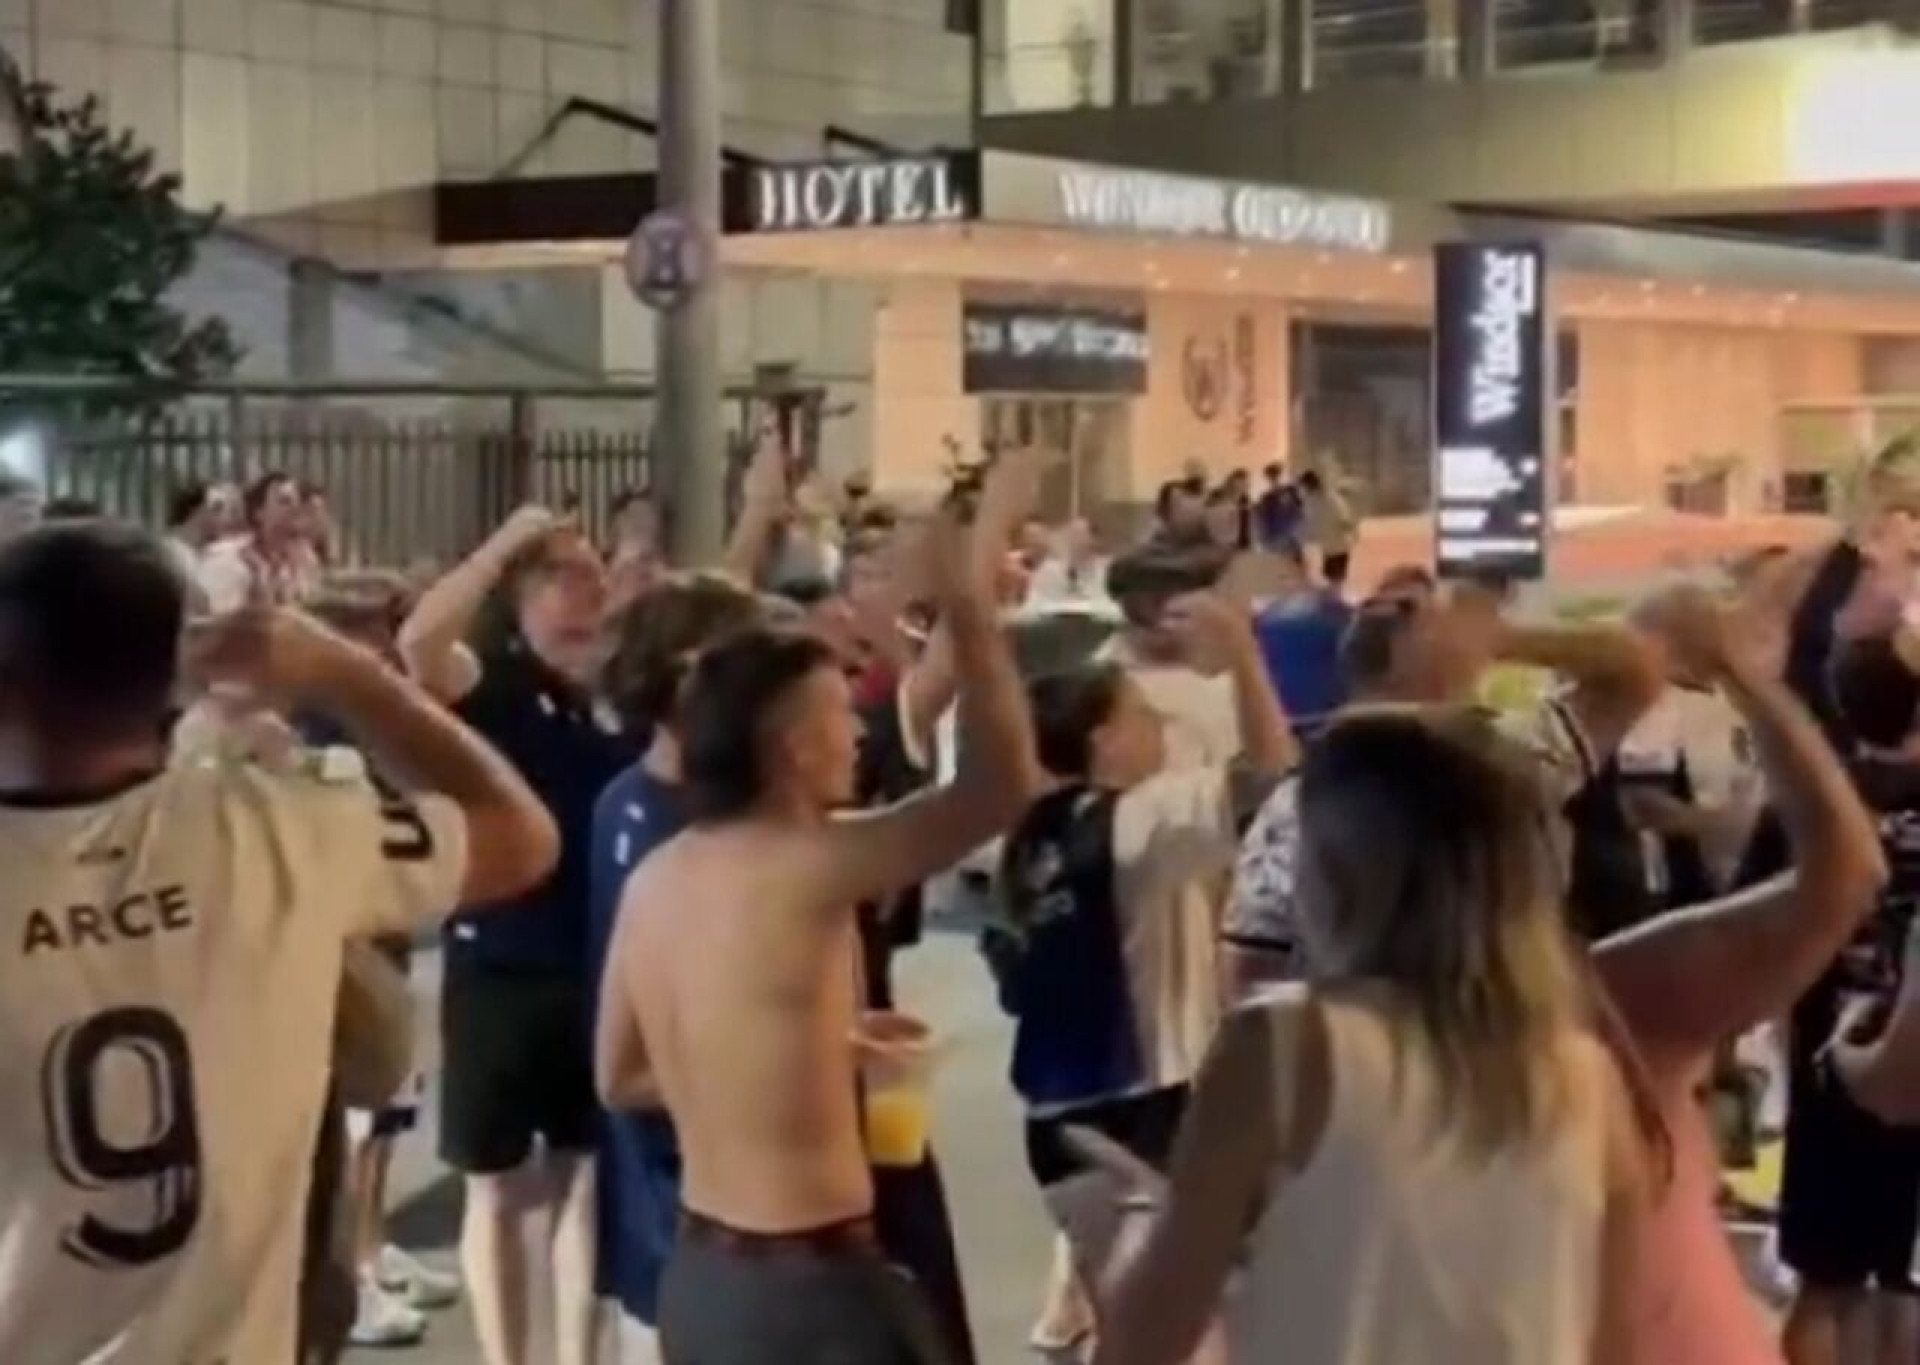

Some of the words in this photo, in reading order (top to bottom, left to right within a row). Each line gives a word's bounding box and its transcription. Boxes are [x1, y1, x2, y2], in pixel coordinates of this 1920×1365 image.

[759, 160, 966, 228] HOTEL
[21, 885, 193, 955] ARCE
[41, 1005, 202, 1267] 9
